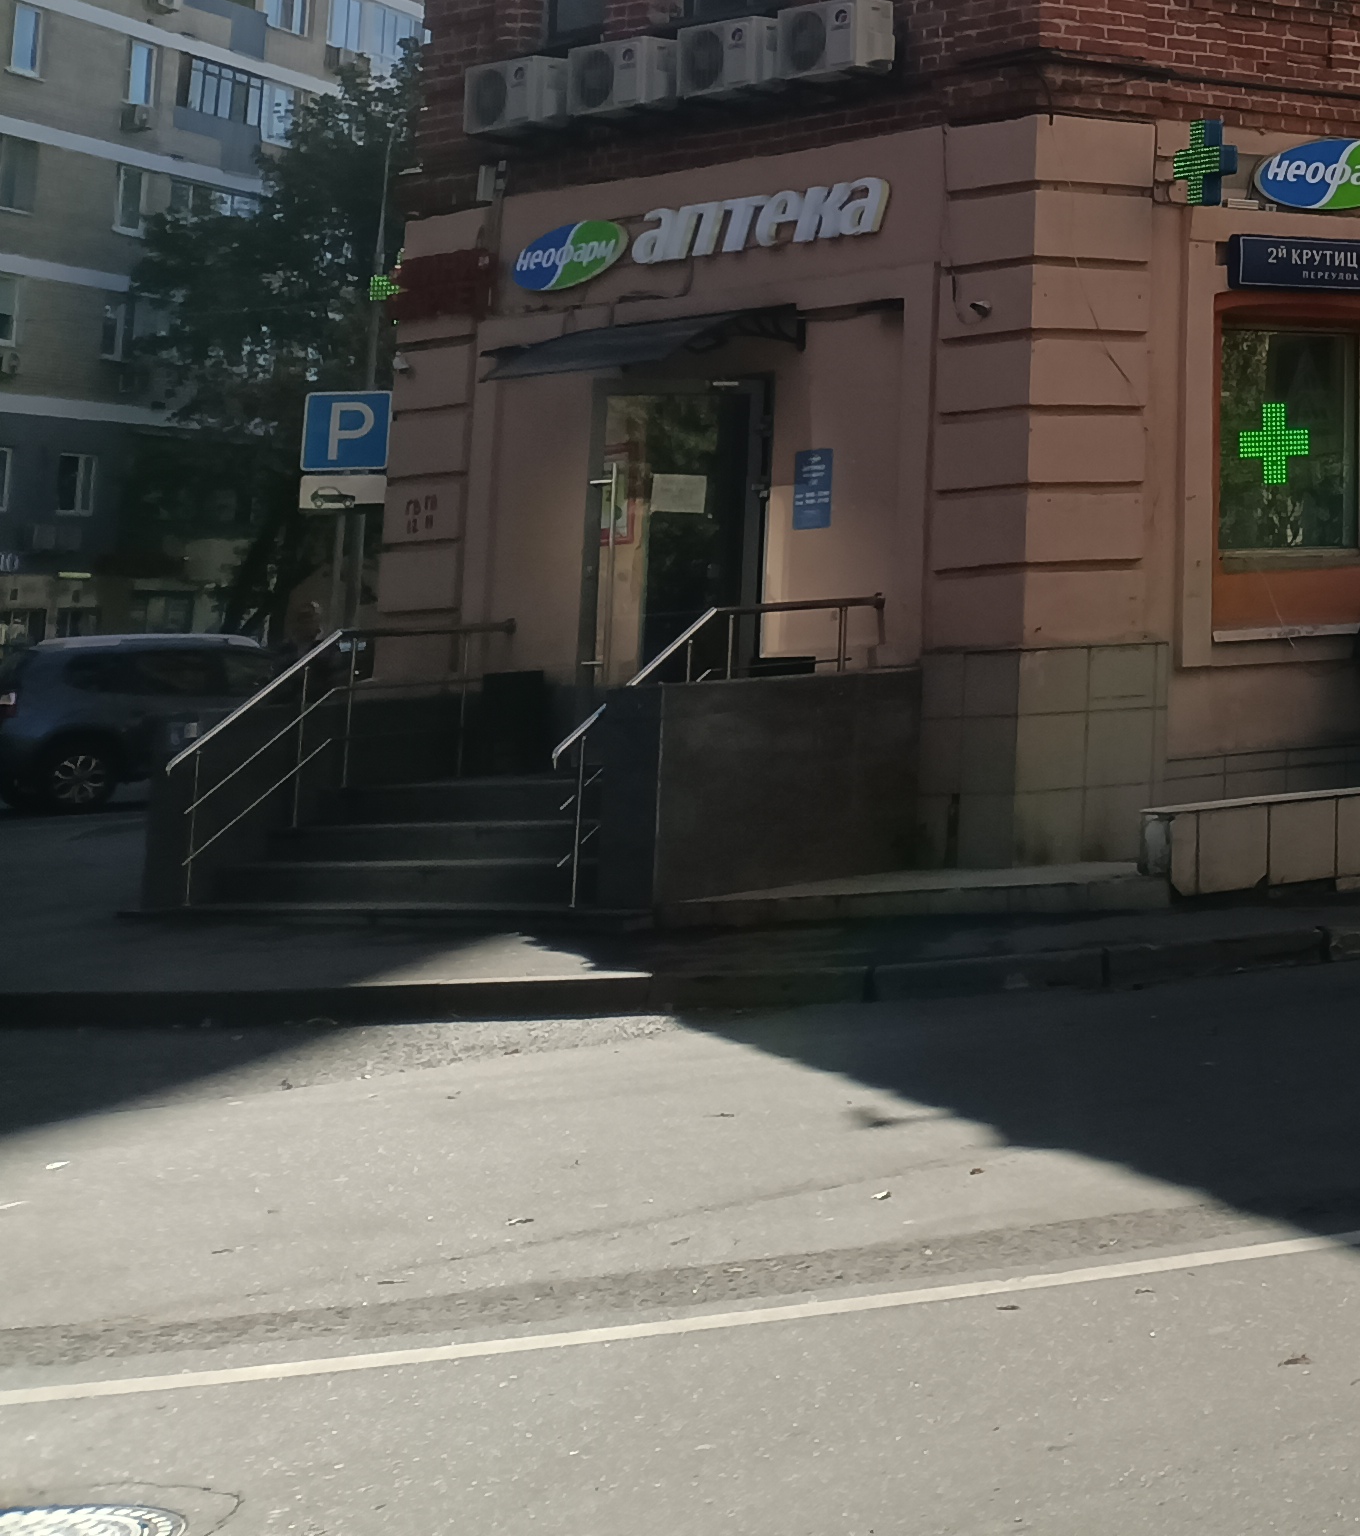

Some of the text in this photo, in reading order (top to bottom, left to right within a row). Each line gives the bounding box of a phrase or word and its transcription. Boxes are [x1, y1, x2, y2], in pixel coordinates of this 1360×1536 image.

[515, 176, 890, 272] неофарм аптека
[1302, 270, 1360, 281] ПЕРЕУЛОК
[328, 401, 375, 461] P
